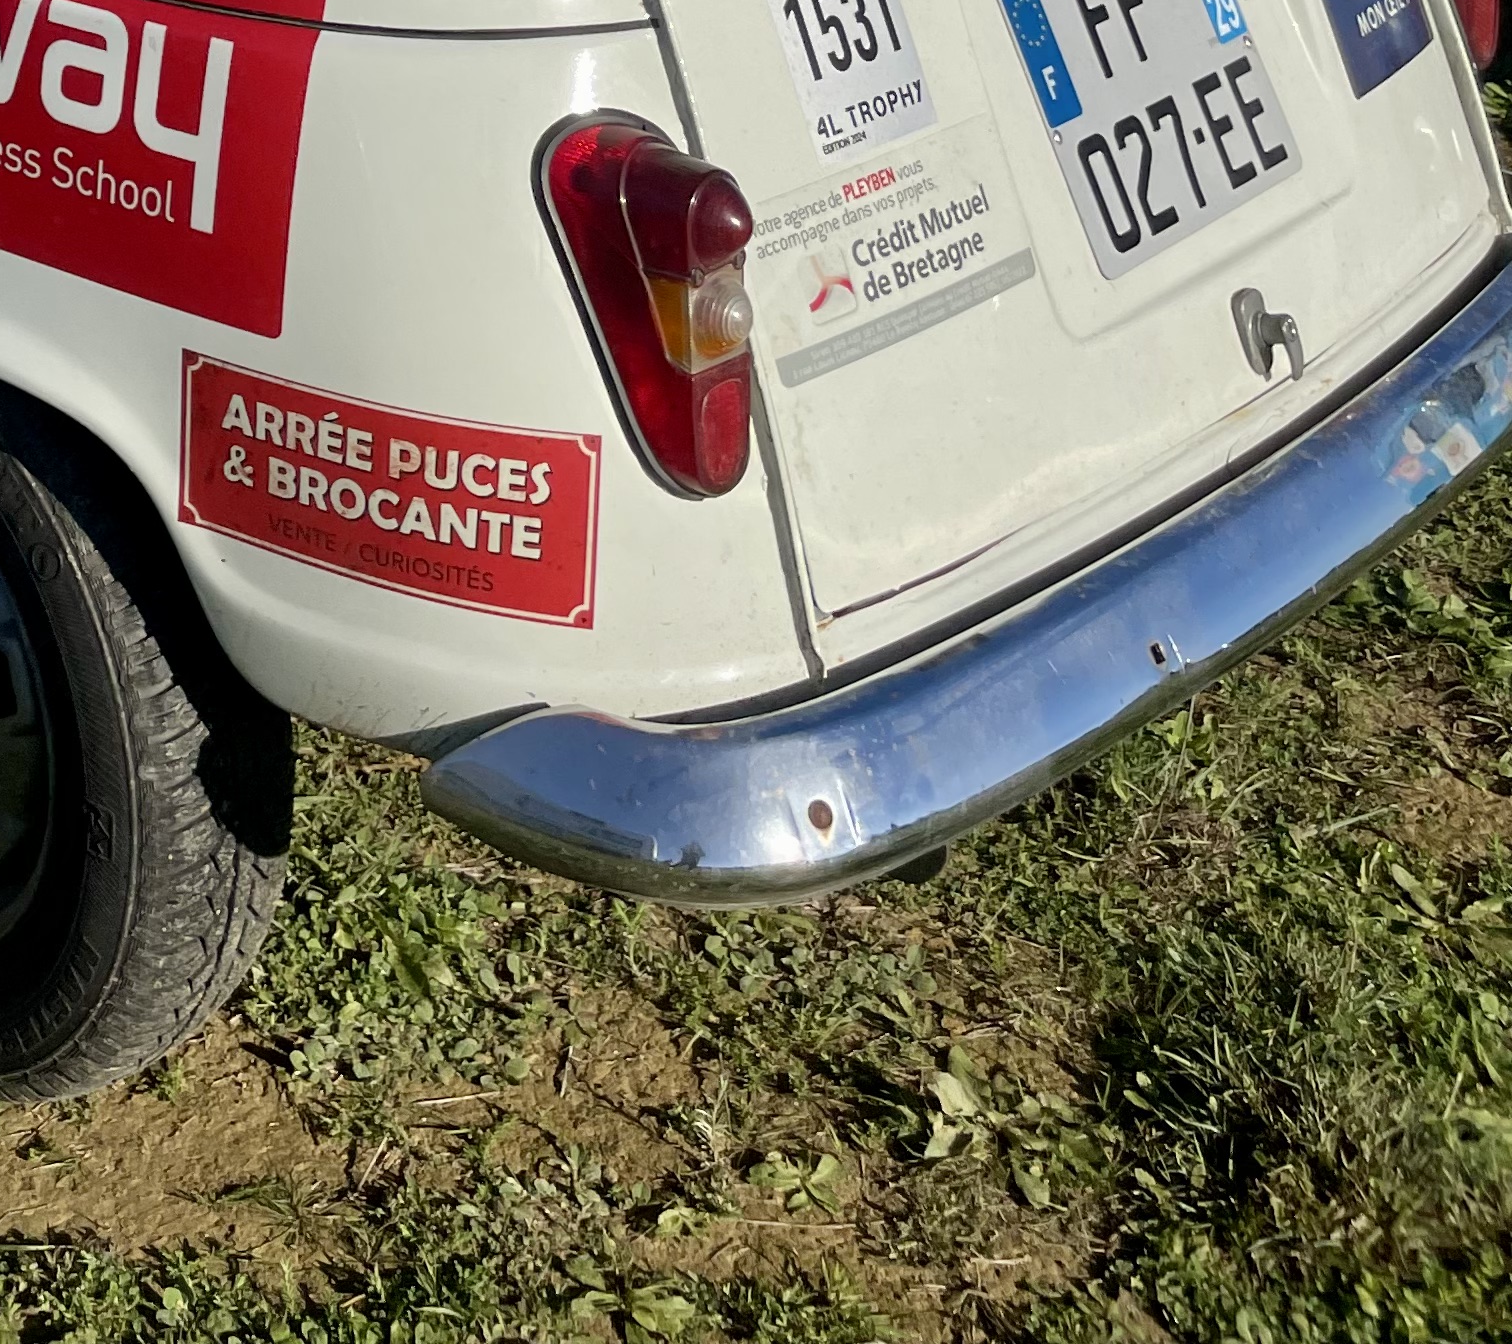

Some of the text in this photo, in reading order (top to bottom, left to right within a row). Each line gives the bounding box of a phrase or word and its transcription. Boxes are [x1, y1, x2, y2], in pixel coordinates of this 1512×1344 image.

[1356, 0, 1386, 38] MON
[816, 79, 923, 139] 4L TROPHY
[1041, 65, 1059, 102] F
[51, 147, 176, 224] School
[783, 200, 828, 230] agence
[827, 190, 843, 209] de
[842, 166, 897, 203] PLEYBEN
[896, 159, 924, 181] vous
[756, 216, 840, 260] accompagne
[842, 203, 873, 227] dans
[873, 194, 896, 213] vos
[851, 183, 990, 268] Crédit Mutuel
[863, 270, 892, 303] de
[891, 231, 986, 290] Bretagne
[221, 393, 553, 506] ARRÉE PUCES
[222, 444, 544, 561] & BROCANTE
[267, 513, 337, 552] VENTE
[358, 543, 495, 592] CURIOSITÉS
